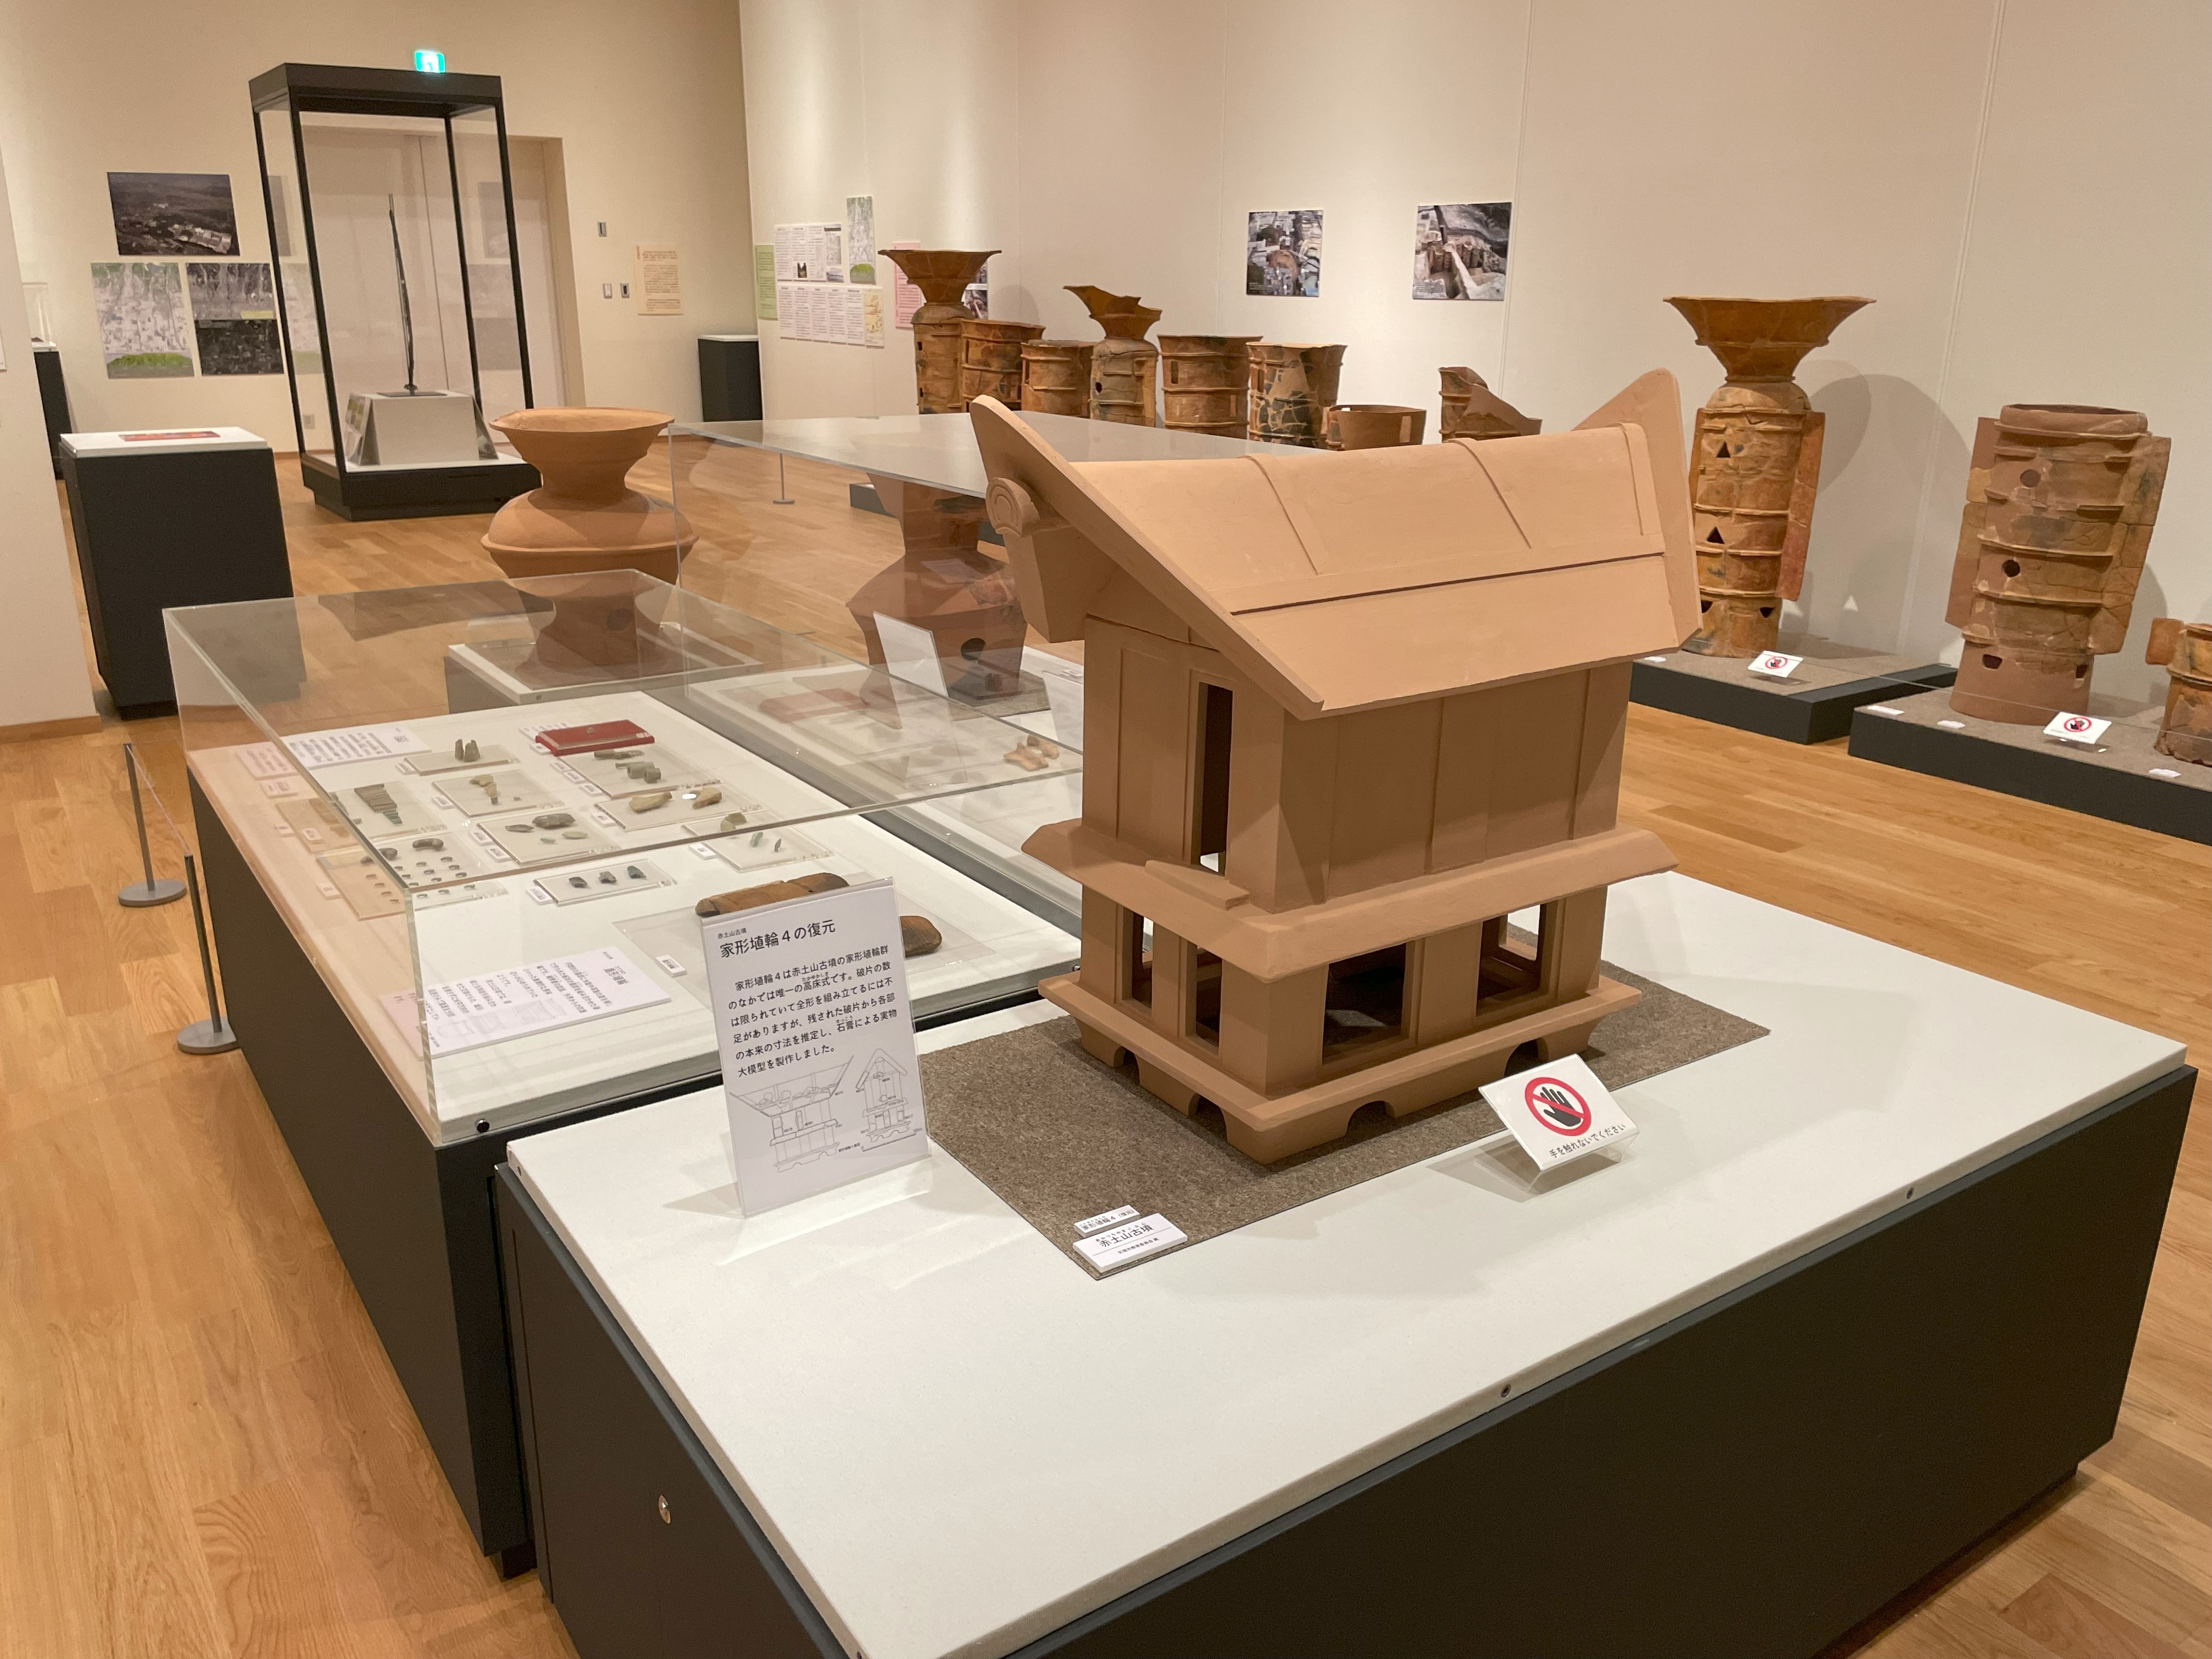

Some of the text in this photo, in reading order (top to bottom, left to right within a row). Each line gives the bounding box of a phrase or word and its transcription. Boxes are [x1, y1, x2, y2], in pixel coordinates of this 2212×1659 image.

[738, 1044, 834, 1077] 大模型を製作しました。
[1549, 1124, 1626, 1159] 手を触れないでください
[1099, 1224, 1154, 1247] 赤土山古墳
